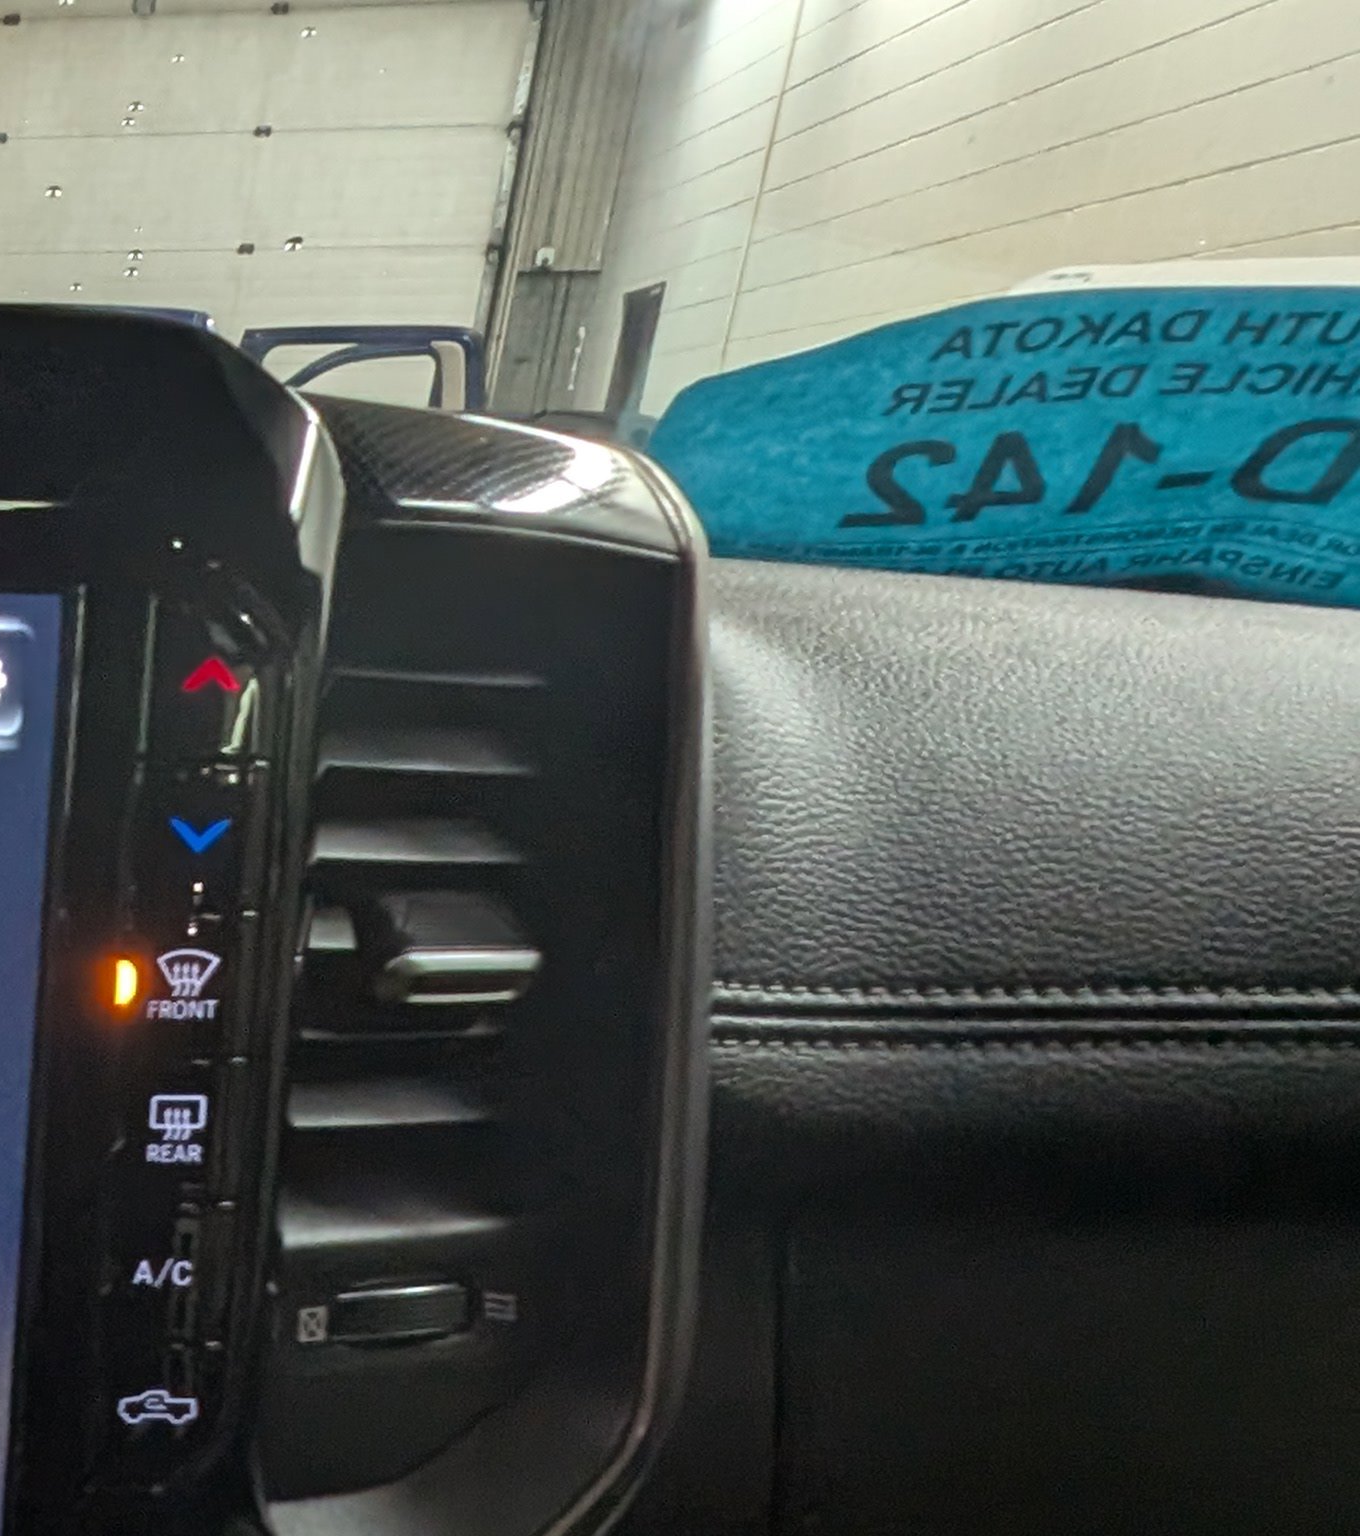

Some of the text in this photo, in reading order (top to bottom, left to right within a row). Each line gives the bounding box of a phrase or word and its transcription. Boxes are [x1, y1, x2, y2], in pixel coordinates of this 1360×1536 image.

[146, 1000, 219, 1020] FRONT
[146, 1144, 203, 1163] REAR
[132, 1260, 194, 1288] A/C
